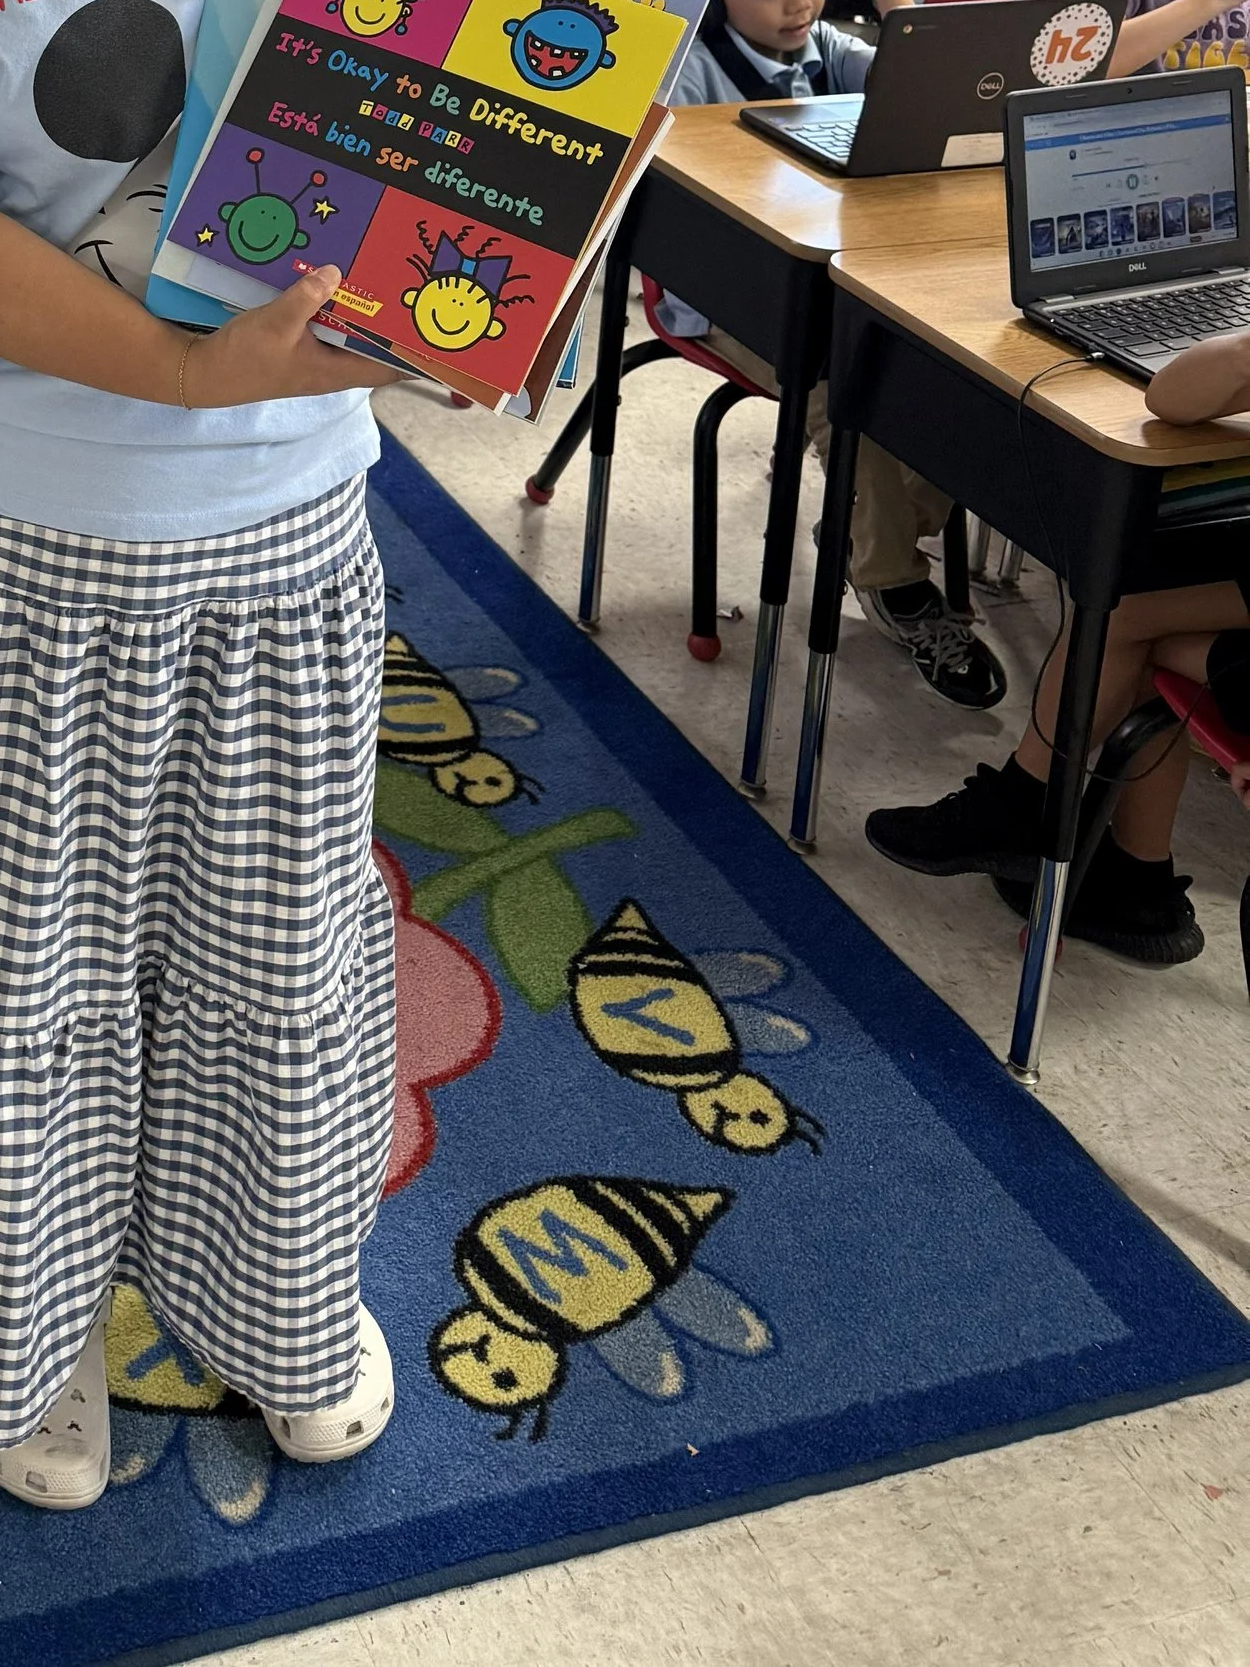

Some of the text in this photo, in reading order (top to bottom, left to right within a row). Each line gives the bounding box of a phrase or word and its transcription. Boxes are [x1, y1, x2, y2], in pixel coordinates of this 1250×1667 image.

[275, 32, 604, 166] It's Okay to Be Different
[418, 120, 474, 155] PARR
[268, 101, 545, 226] Está bien ser diferente
[1128, 263, 1147, 272] DELL
[341, 293, 375, 313] español
